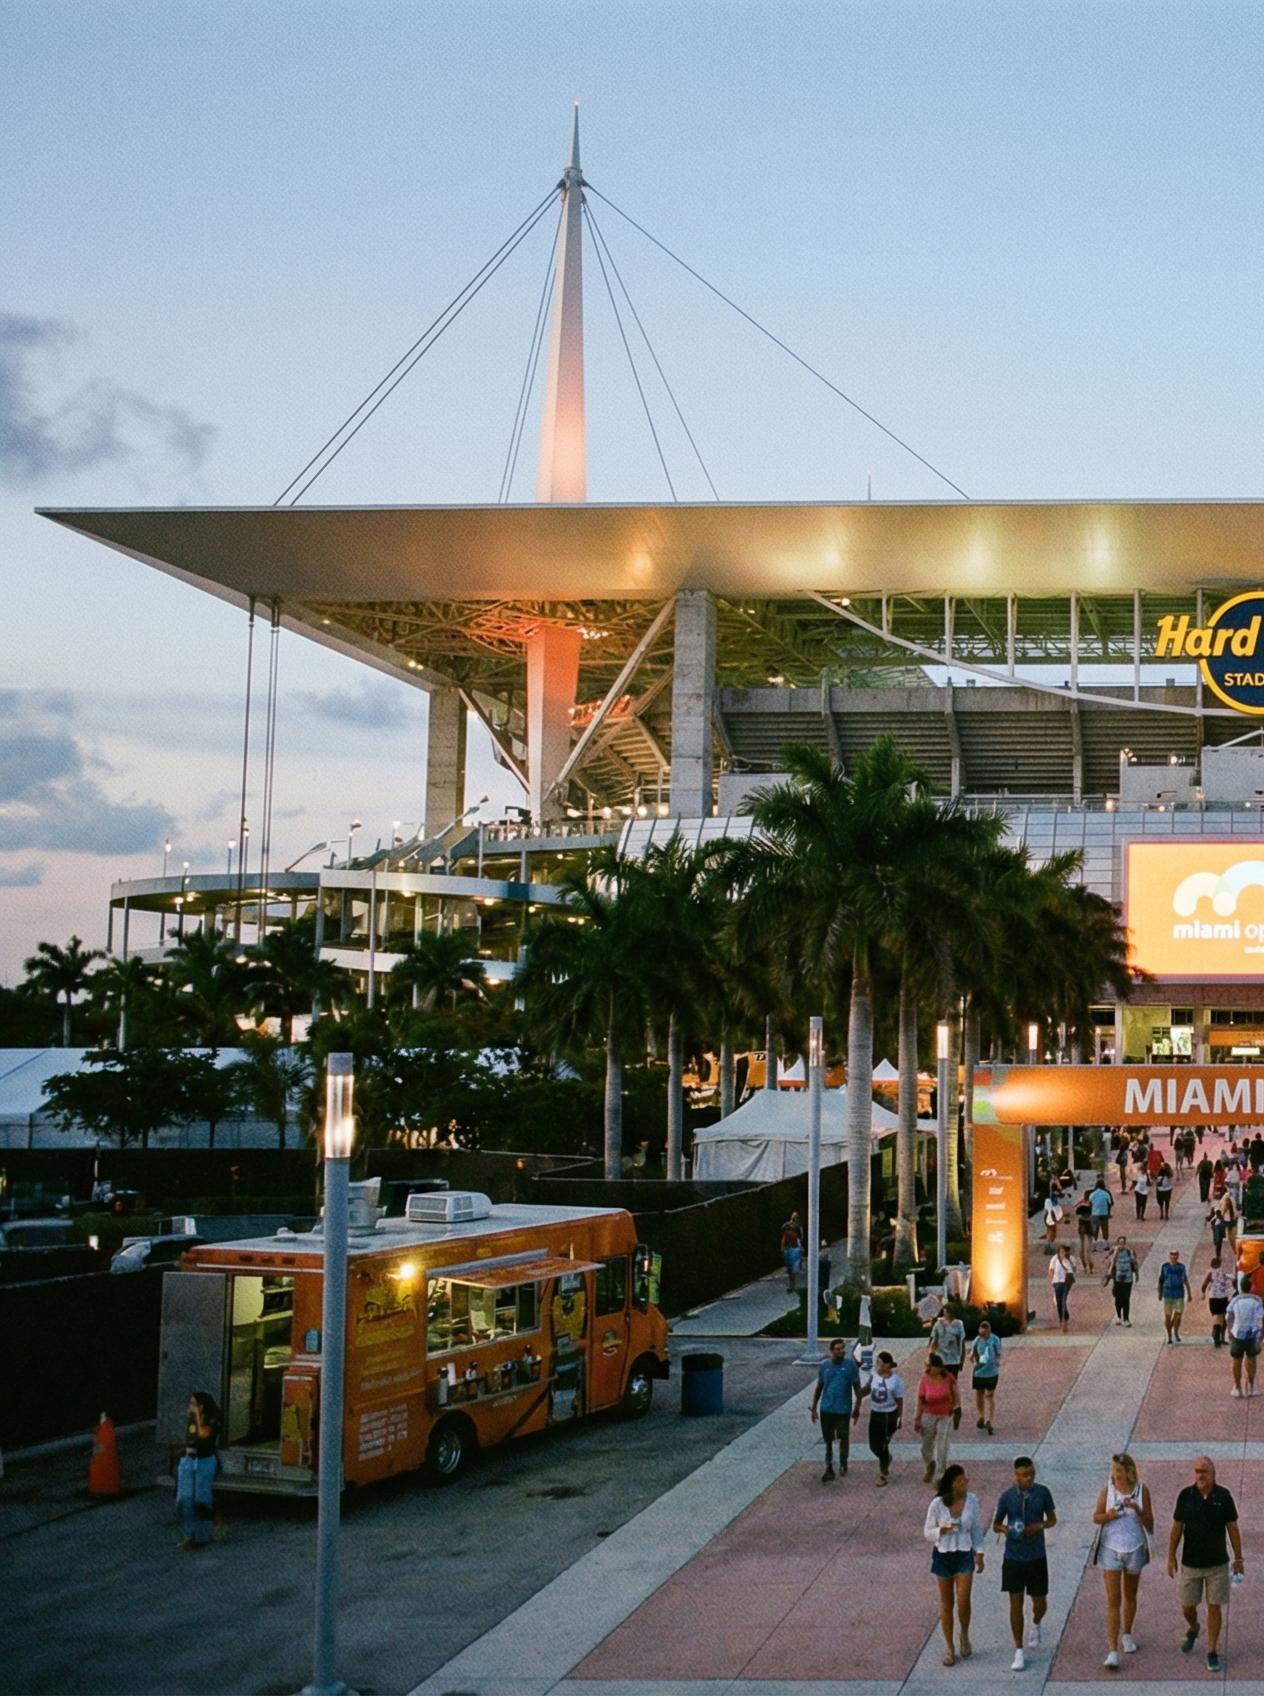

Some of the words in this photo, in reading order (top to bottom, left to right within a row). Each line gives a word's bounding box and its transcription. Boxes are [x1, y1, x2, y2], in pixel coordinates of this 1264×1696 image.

[1154, 614, 1262, 658] Hard
[1173, 918, 1241, 940] miami
[1124, 1078, 1264, 1114] MIAMI
